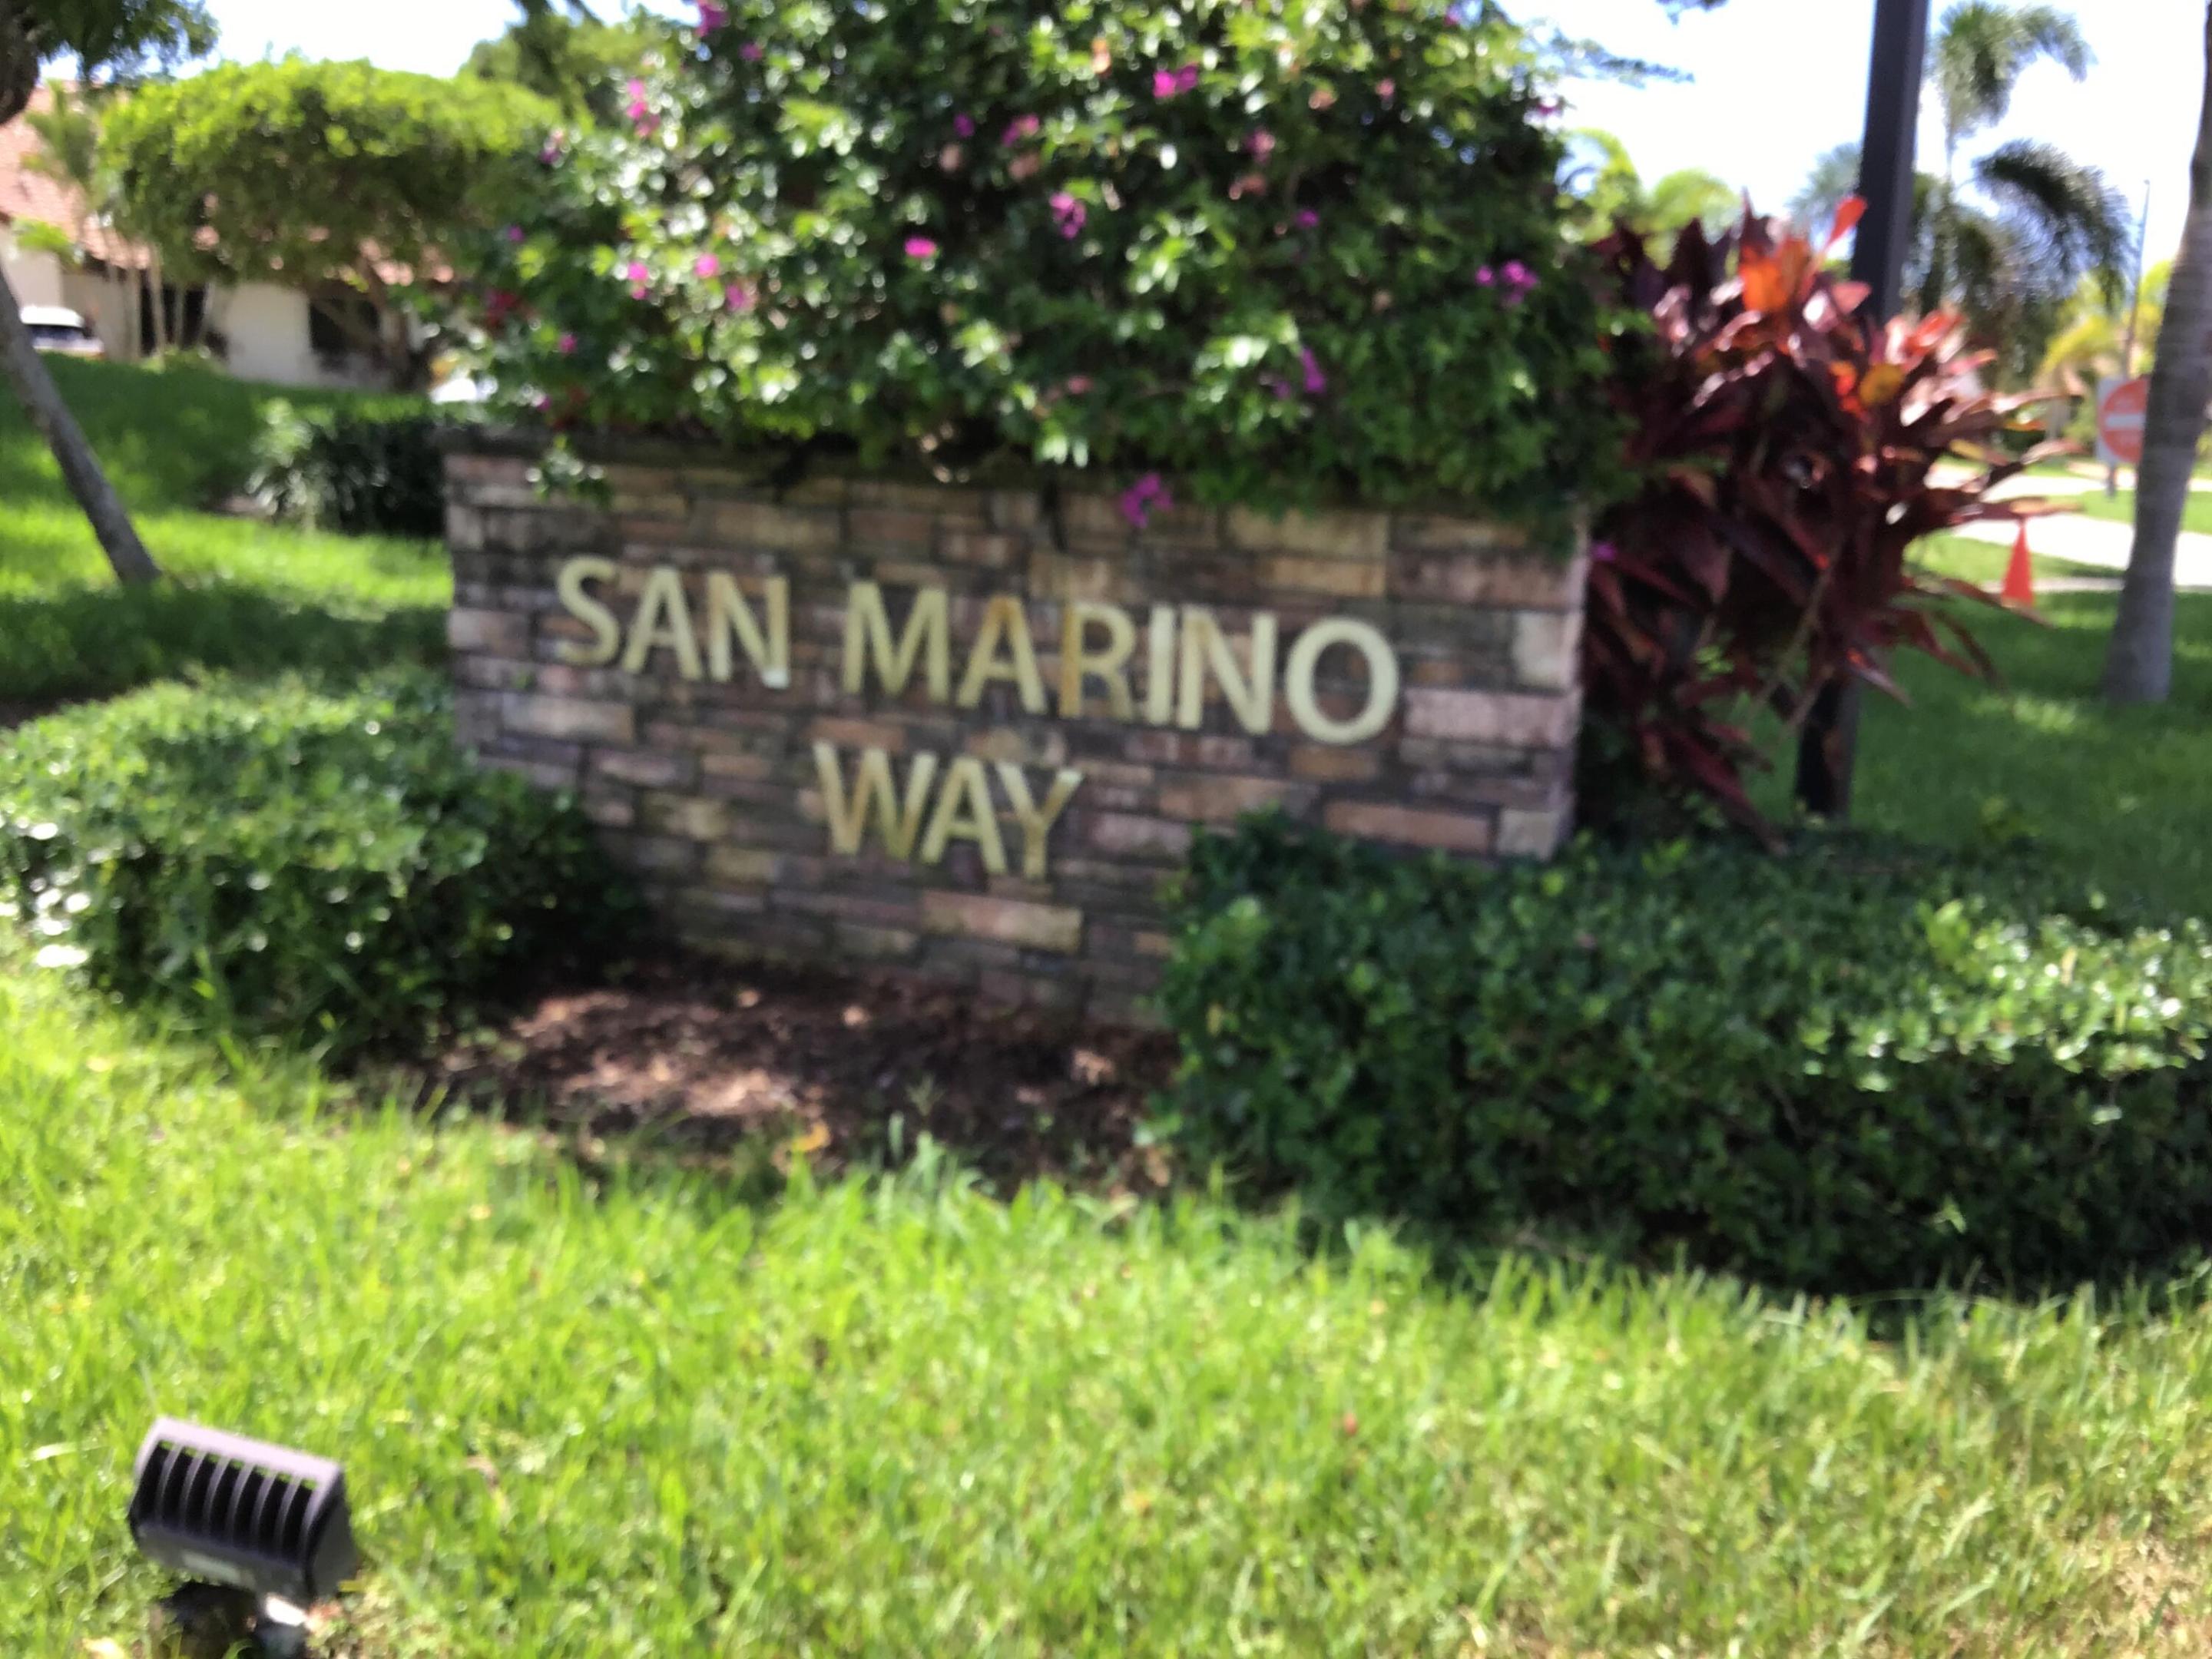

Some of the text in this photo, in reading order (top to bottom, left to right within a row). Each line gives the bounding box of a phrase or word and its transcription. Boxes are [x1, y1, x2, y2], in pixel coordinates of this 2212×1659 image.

[556, 556, 1399, 743] SAN MARINO
[813, 743, 1082, 879] WAY
